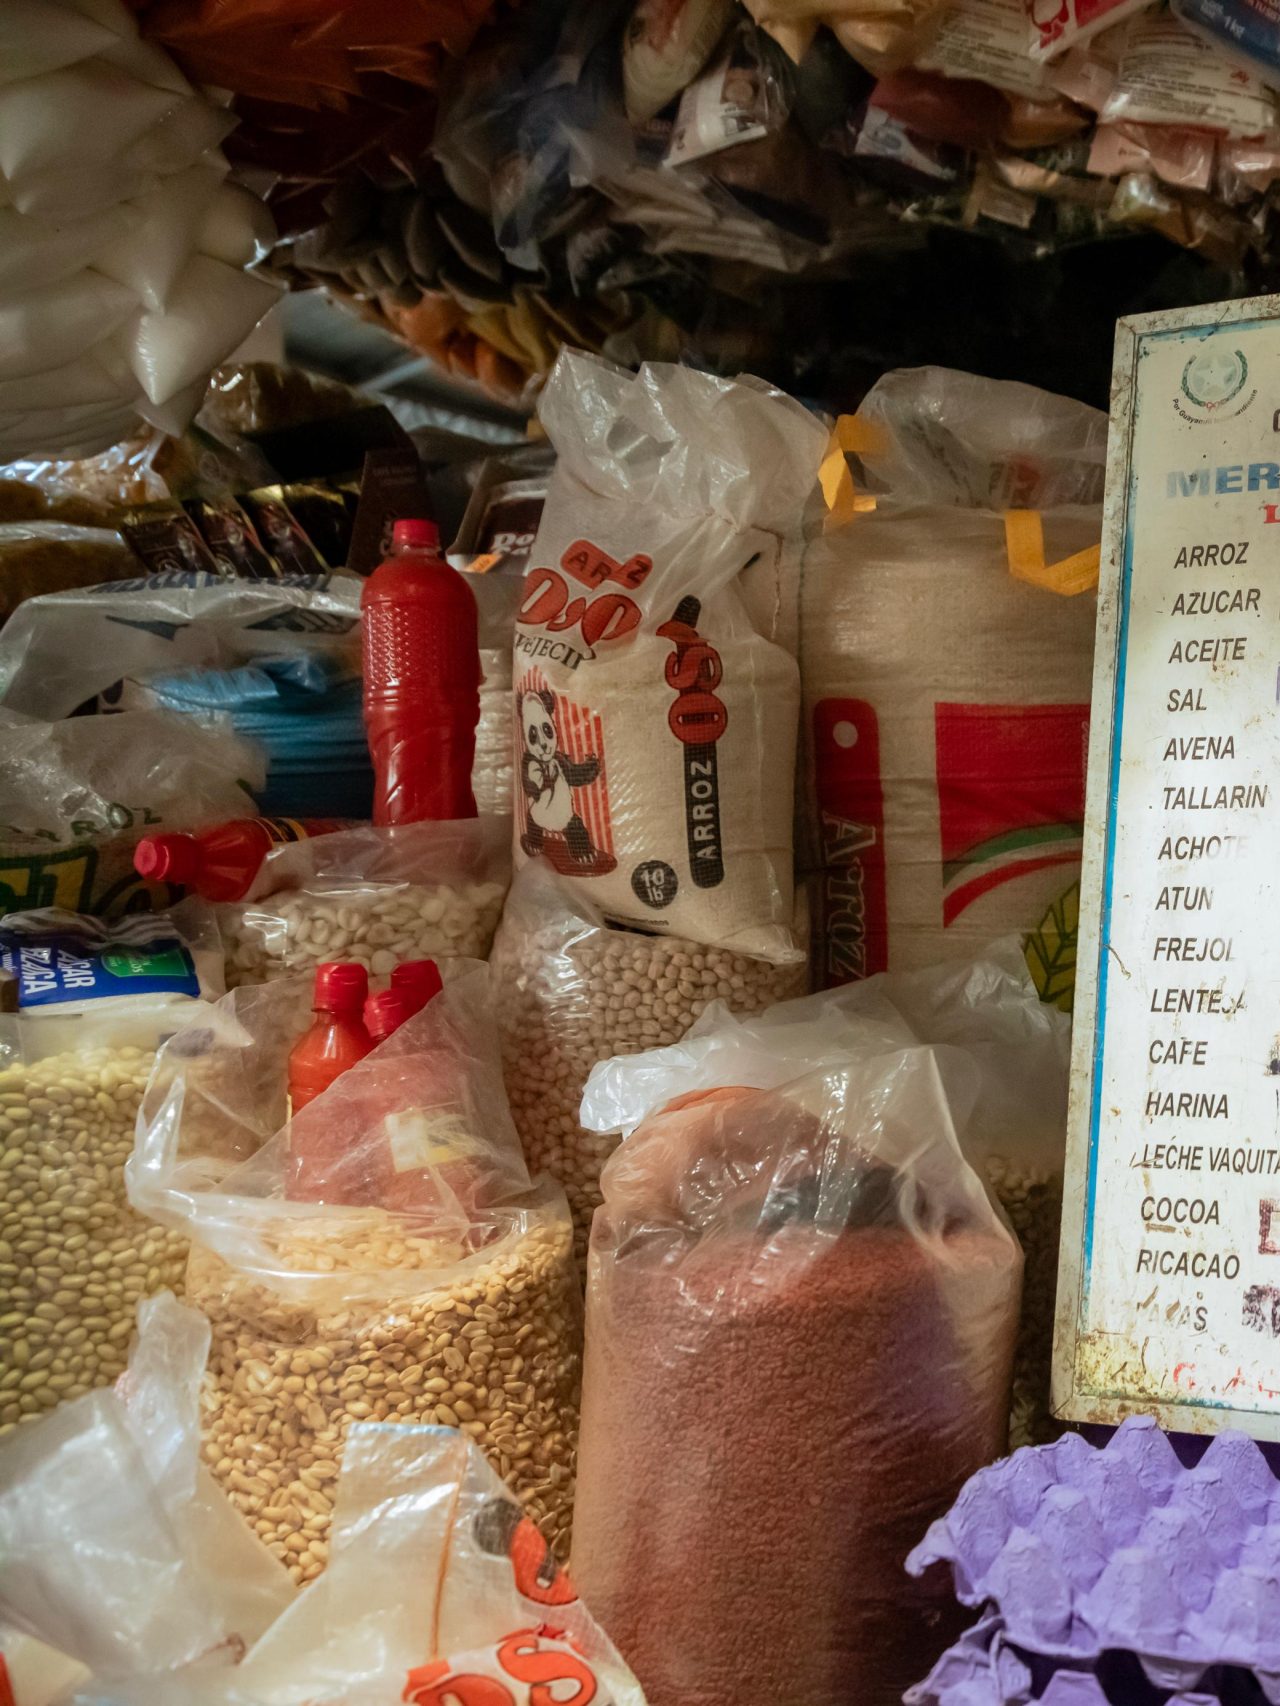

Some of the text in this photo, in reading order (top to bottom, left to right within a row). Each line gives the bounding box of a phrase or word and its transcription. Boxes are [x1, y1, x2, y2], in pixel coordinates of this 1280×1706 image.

[1174, 541, 1249, 569] ARROZ
[1171, 588, 1261, 616] AZUCAR
[1168, 637, 1247, 664] ACEITE
[1167, 688, 1207, 712] SAL
[1163, 736, 1235, 761] AVENA
[692, 759, 718, 863] ARROZ
[1163, 785, 1268, 810] TALLARIN
[1155, 886, 1213, 910] ATUN
[1153, 937, 1235, 962] FREJOL
[1149, 1040, 1208, 1066] CAFE
[1145, 1092, 1229, 1119] HARINA
[1141, 1144, 1202, 1171] LECHE
[1141, 1197, 1220, 1225] COCOA
[1137, 1249, 1240, 1280] RICACAO
